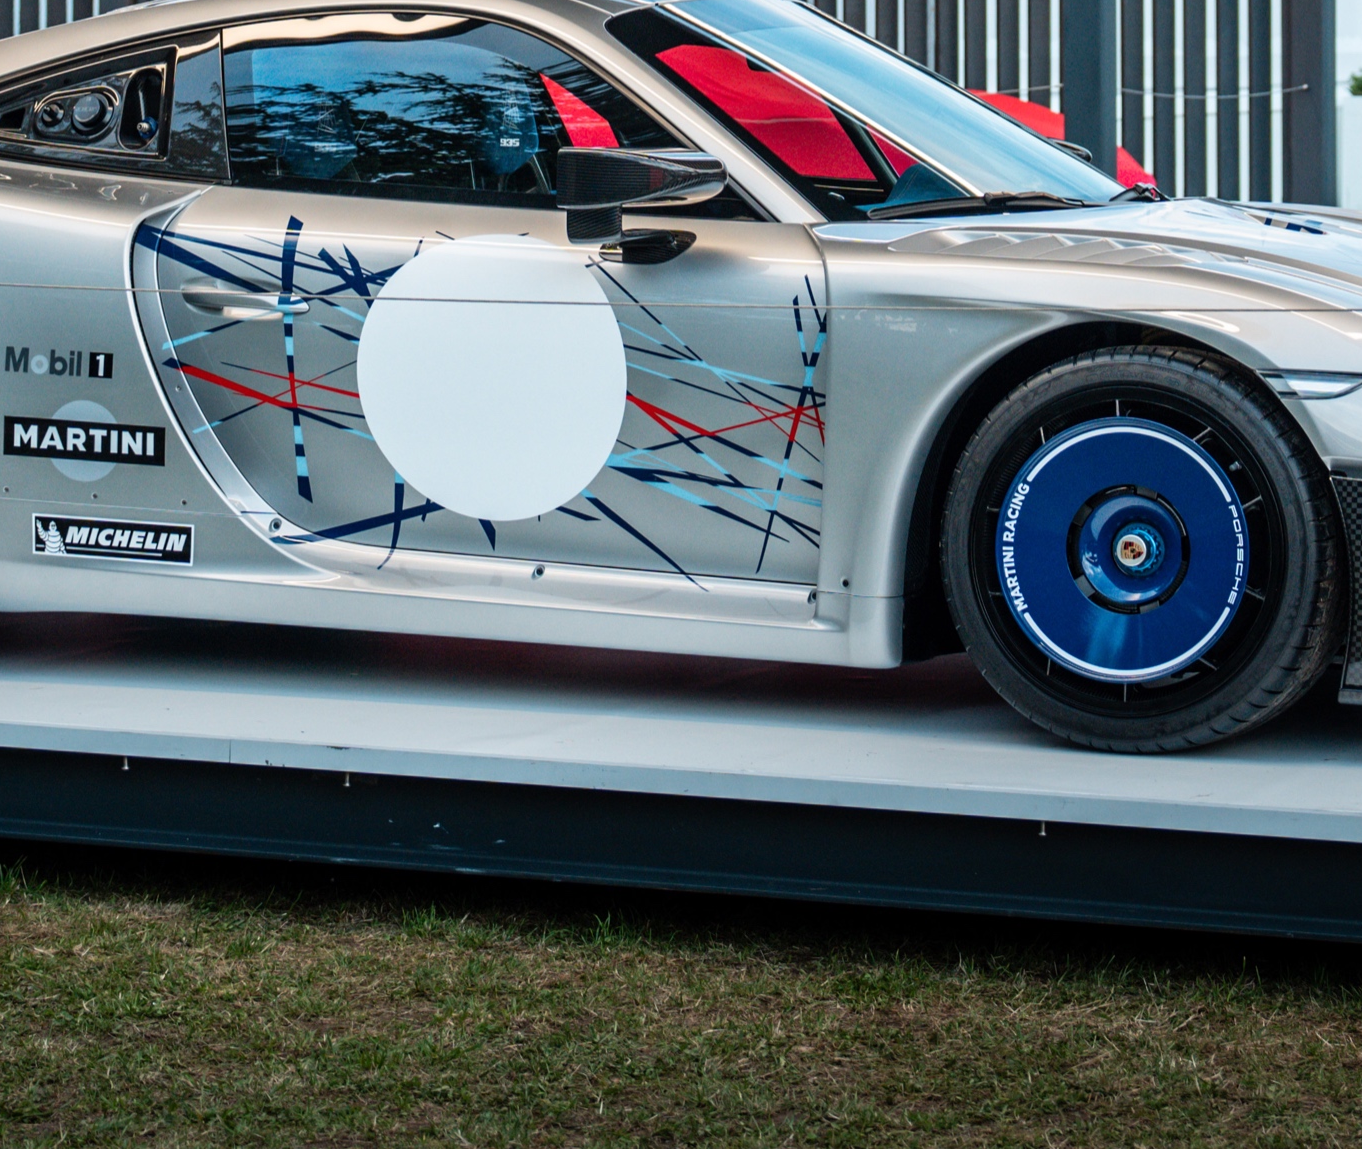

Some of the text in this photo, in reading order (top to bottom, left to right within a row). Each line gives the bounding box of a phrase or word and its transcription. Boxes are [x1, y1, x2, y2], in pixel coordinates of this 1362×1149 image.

[500, 137, 520, 147] 935
[4, 346, 82, 377] Mobil
[13, 422, 155, 457] MARTINI
[65, 525, 188, 552] MICHELIN
[1002, 481, 1030, 615] MARTINI RACING
[1228, 504, 1245, 605] PORSCHE
